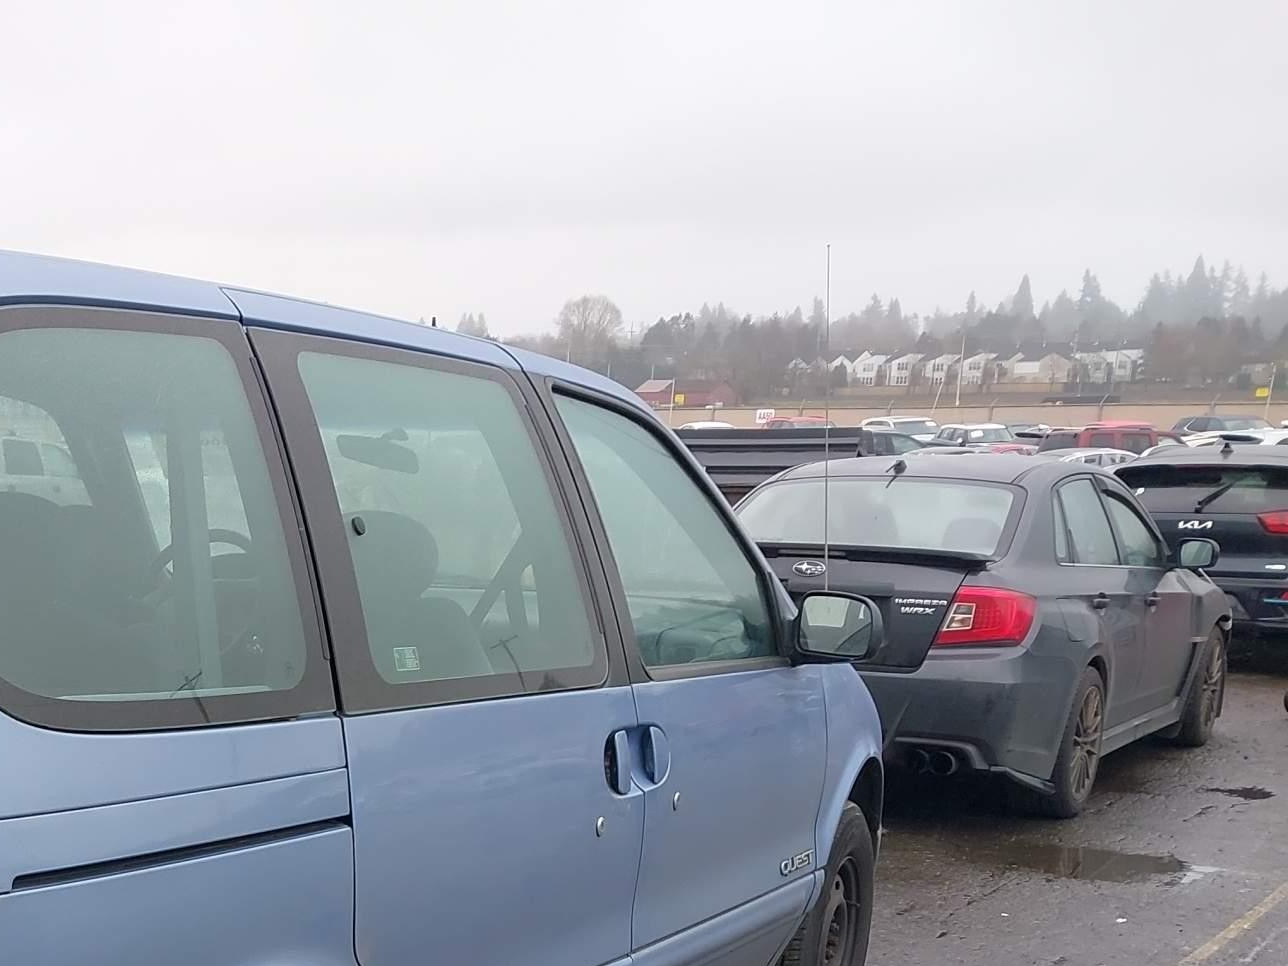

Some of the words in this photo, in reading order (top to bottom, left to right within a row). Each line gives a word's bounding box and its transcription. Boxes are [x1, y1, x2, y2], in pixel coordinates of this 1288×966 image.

[1178, 520, 1213, 529] KIA
[895, 598, 948, 606] IMPREZA
[901, 606, 936, 615] WRX
[780, 849, 814, 877] QUEST
